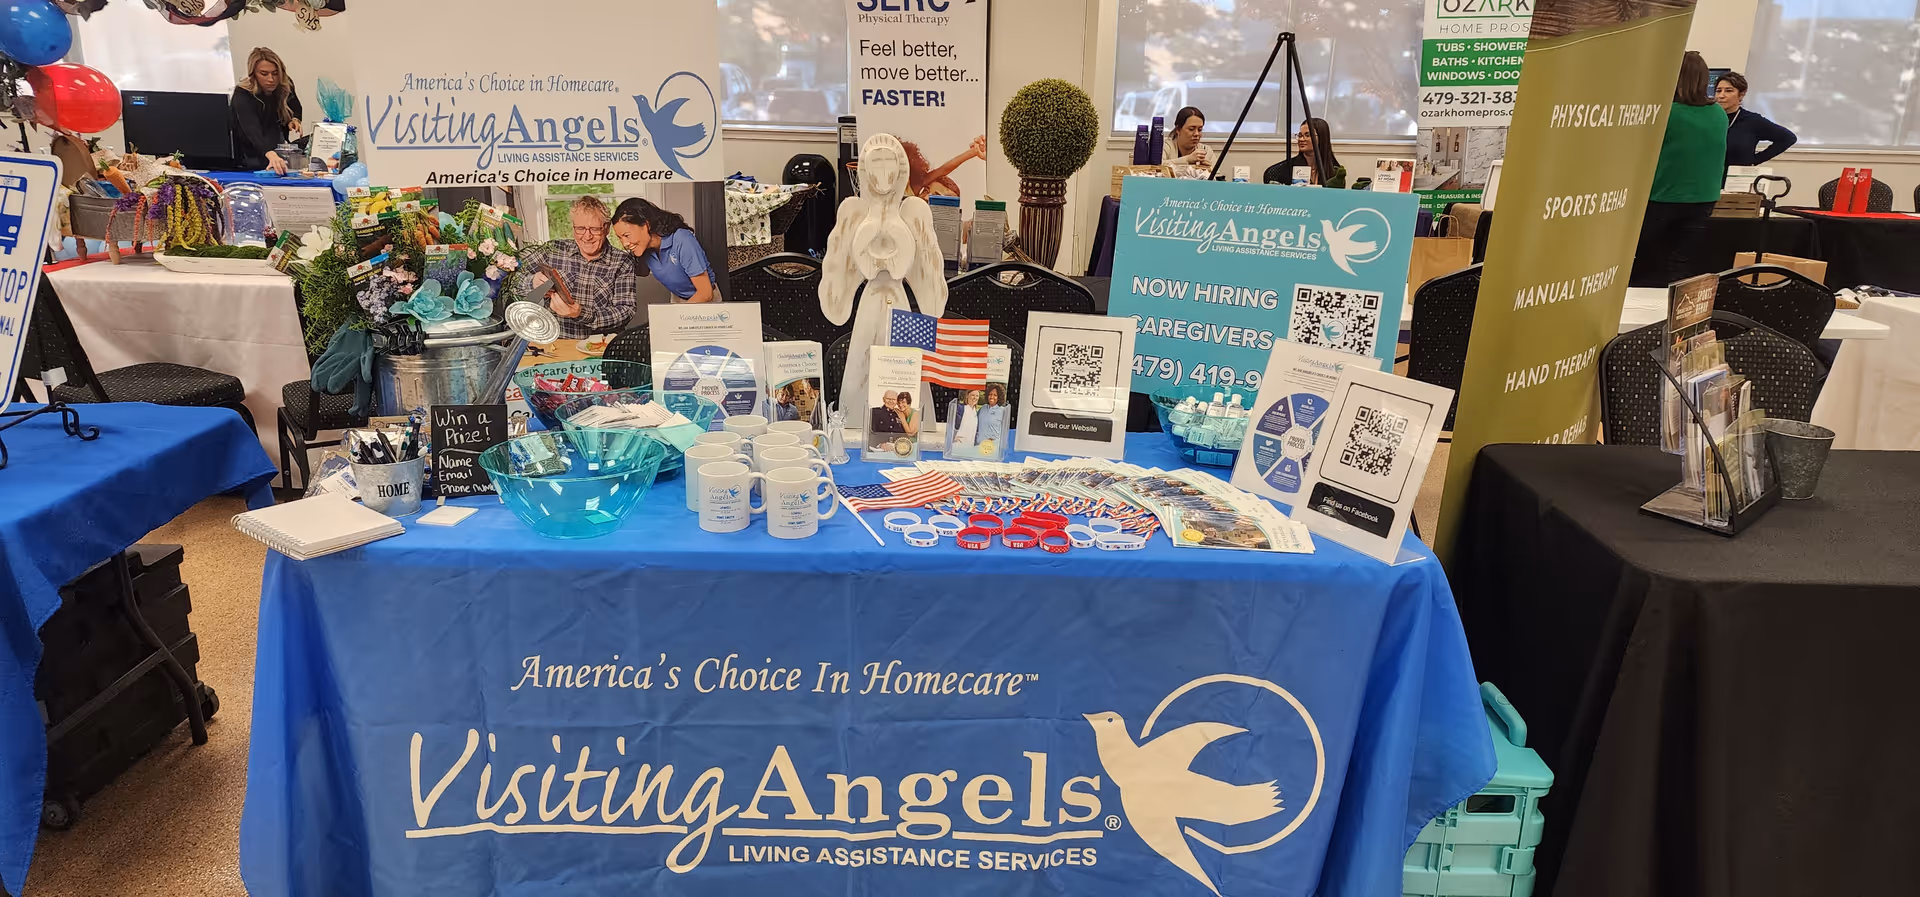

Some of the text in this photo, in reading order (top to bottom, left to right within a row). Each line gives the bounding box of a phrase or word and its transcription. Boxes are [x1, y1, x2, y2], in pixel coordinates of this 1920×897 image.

[858, 13, 950, 27] Physical Therapy
[1439, 22, 1530, 34] HOME PROS
[859, 40, 957, 60] Feel better,
[1436, 42, 1465, 52] TUBS
[1432, 56, 1524, 66] BATHS KITCHEN
[861, 64, 979, 82] move better...
[1427, 70, 1520, 81] WINDOWS DOO
[400, 72, 475, 92] America's
[479, 73, 525, 93] Choice
[529, 75, 543, 92] in
[862, 89, 946, 107] FASTER!
[1421, 107, 1514, 119] ozarkhomepros.c
[1550, 103, 1662, 128] PHYSICAL THERAPY
[497, 151, 639, 163] LIVING ASSISTANCE SERVICES
[426, 167, 673, 185] America's Choice in Homecare
[1159, 196, 1208, 211] America's
[1210, 199, 1242, 213] Choice
[1245, 202, 1255, 214] in
[1543, 187, 1628, 220] SPORTS REHAB
[1212, 244, 1317, 261] LIVING ASSISTANCE SERVICES
[0, 267, 28, 304] TOP
[1132, 276, 1279, 310] NOW HIRING
[1513, 264, 1619, 312] MANUAL THERAPY
[1130, 314, 1274, 351] CAREGIVERS
[543, 367, 567, 376] care
[570, 364, 587, 374] for
[589, 364, 603, 374] yo
[1132, 354, 1183, 386] 479)
[1189, 363, 1262, 392] 419-9
[1504, 344, 1597, 393] HAND THERAPY
[434, 410, 492, 427] Win a
[1044, 421, 1098, 433] Visit our Website
[445, 427, 491, 446] Prize!
[1562, 415, 1588, 444] REHAB
[438, 455, 473, 469] Name
[438, 469, 473, 482] Email
[377, 482, 410, 498] HOME
[440, 484, 471, 494] Phone
[1322, 496, 1336, 507] Find
[1335, 501, 1343, 509] us
[1350, 507, 1379, 523] Facebook
[510, 652, 682, 692] America's
[694, 652, 802, 693] Choice
[812, 661, 850, 694] In
[410, 728, 739, 874] Visiting
[728, 845, 1097, 871] LIVING ASSISTANCE SERVICES
